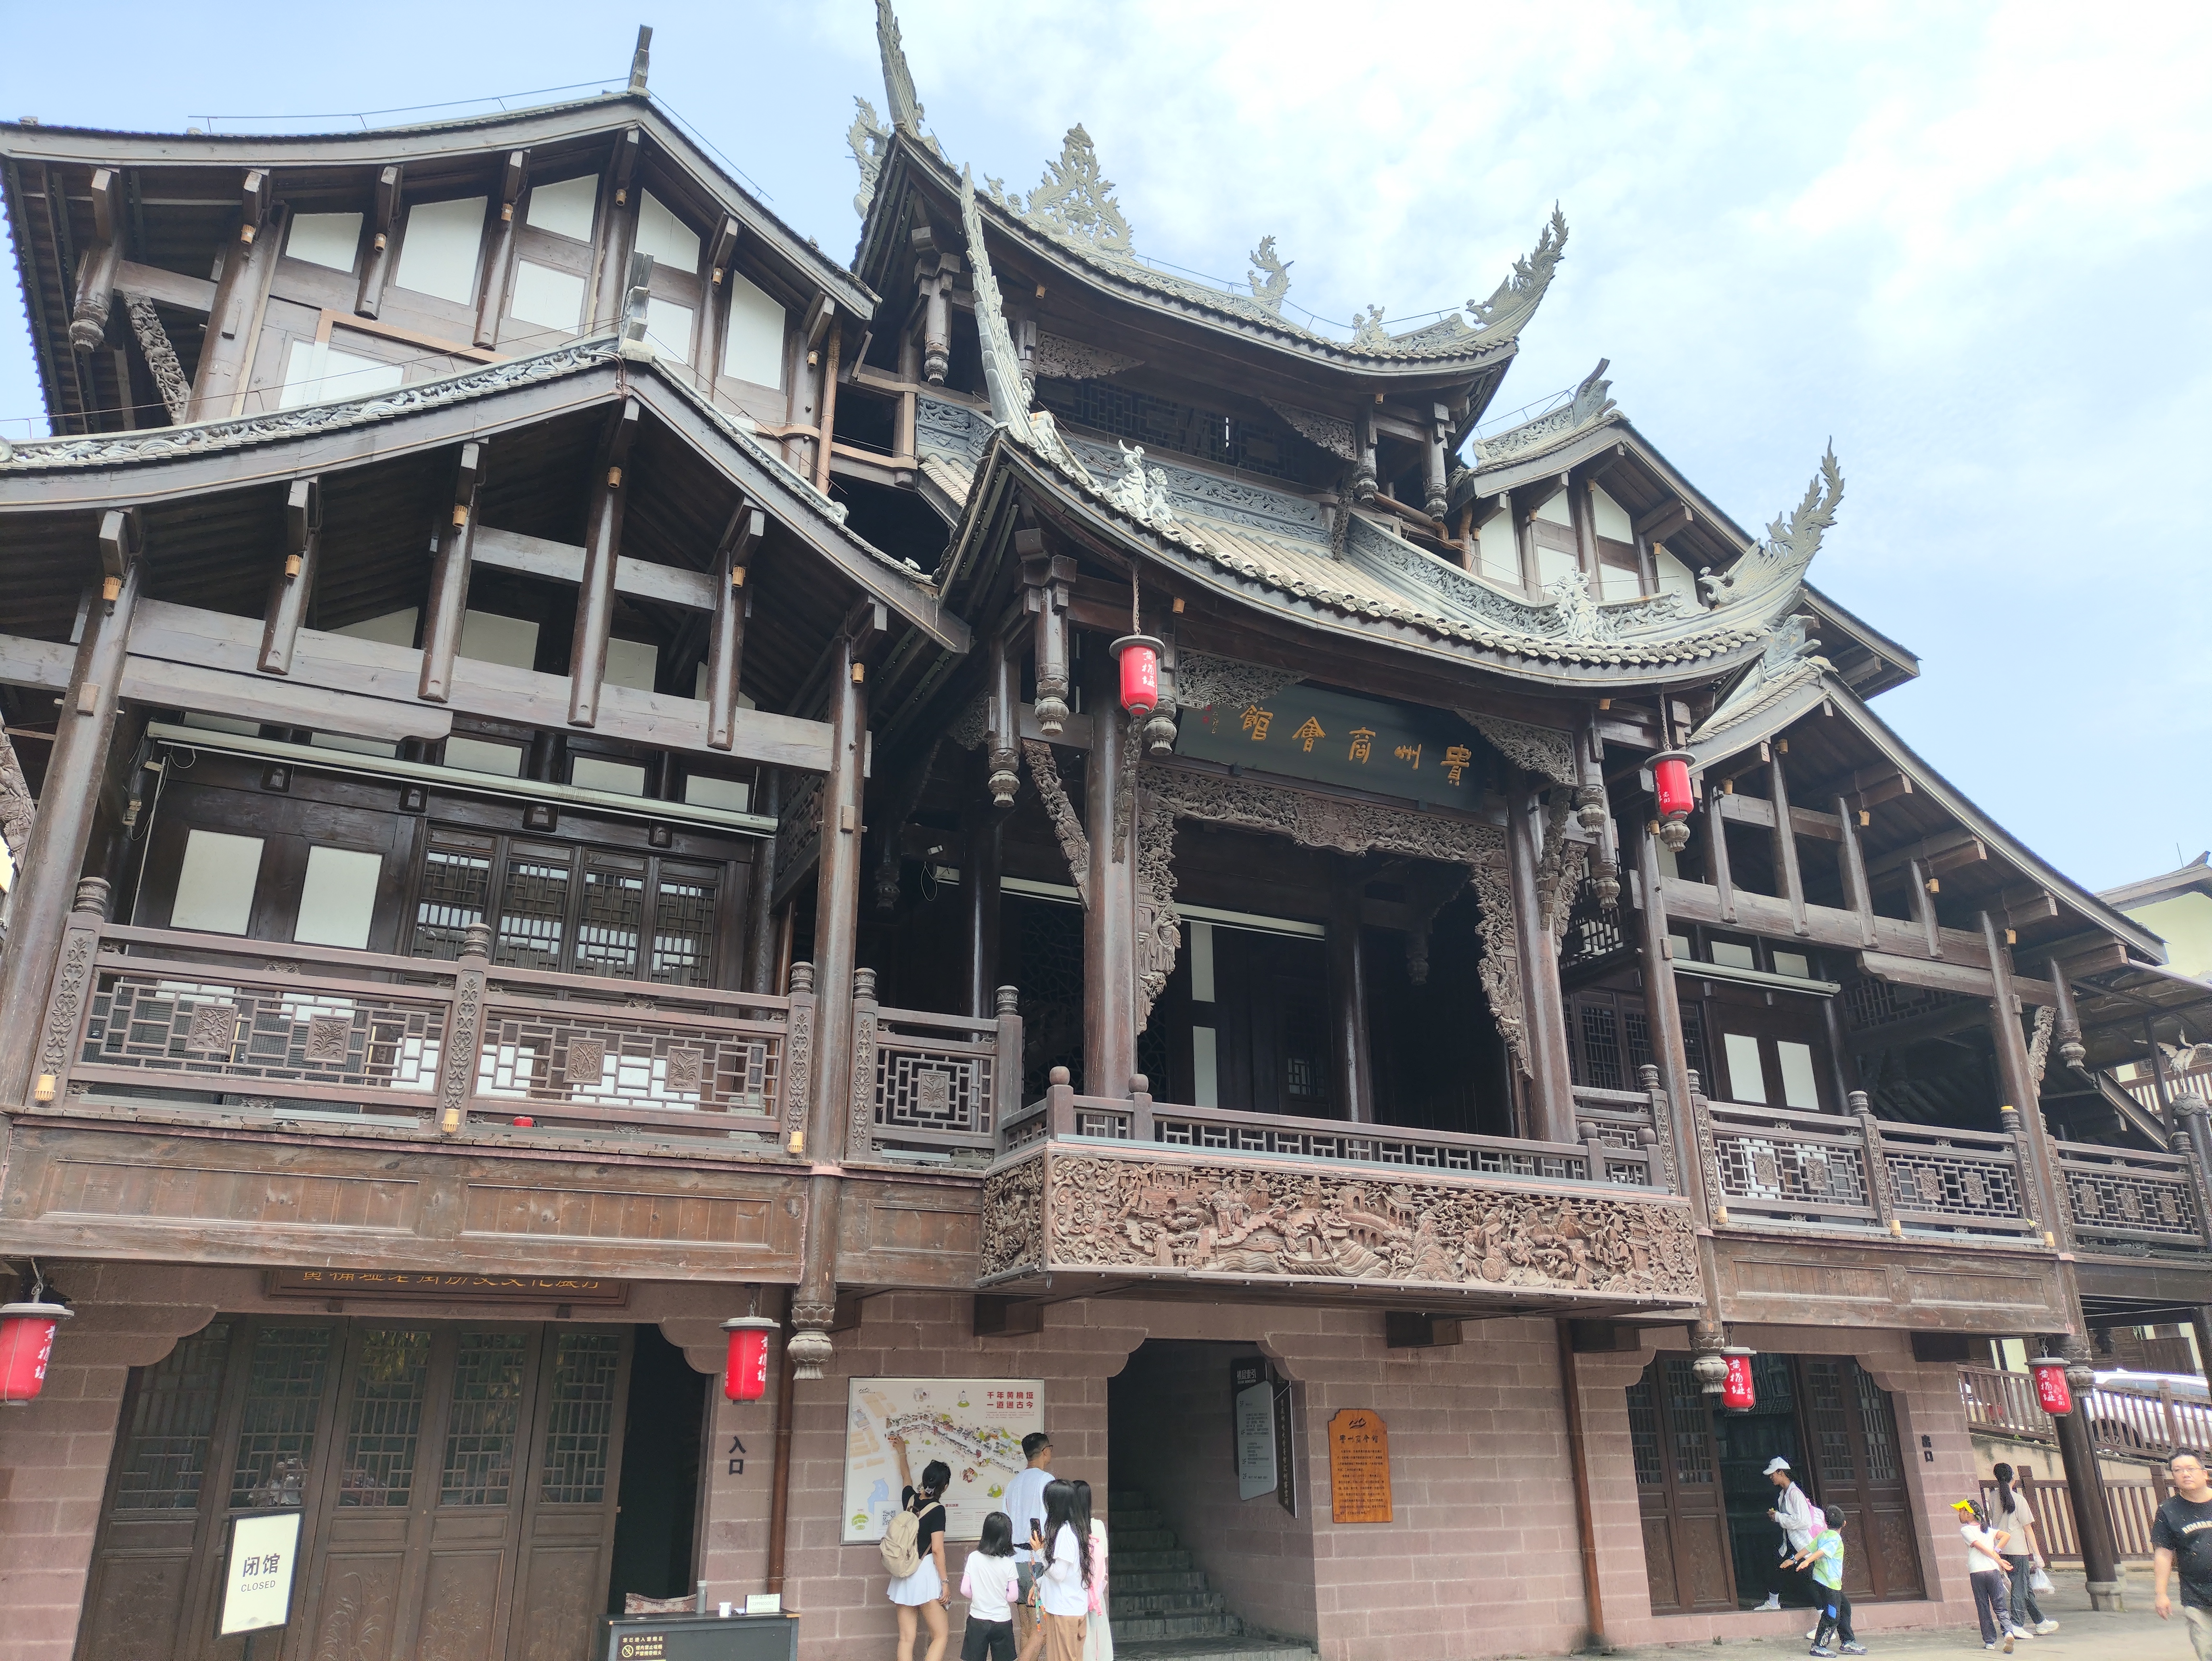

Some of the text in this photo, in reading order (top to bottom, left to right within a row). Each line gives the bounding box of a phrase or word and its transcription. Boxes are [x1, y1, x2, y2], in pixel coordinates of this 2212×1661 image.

[1237, 1368, 1256, 1380] 楼层索引
[987, 1391, 1033, 1399] 千年黄桷垭
[729, 1436, 747, 1475] 入口
[1921, 1434, 1934, 1462] 出口
[243, 1553, 280, 1577] 闭馆
[241, 1580, 276, 1592] CLOSED
